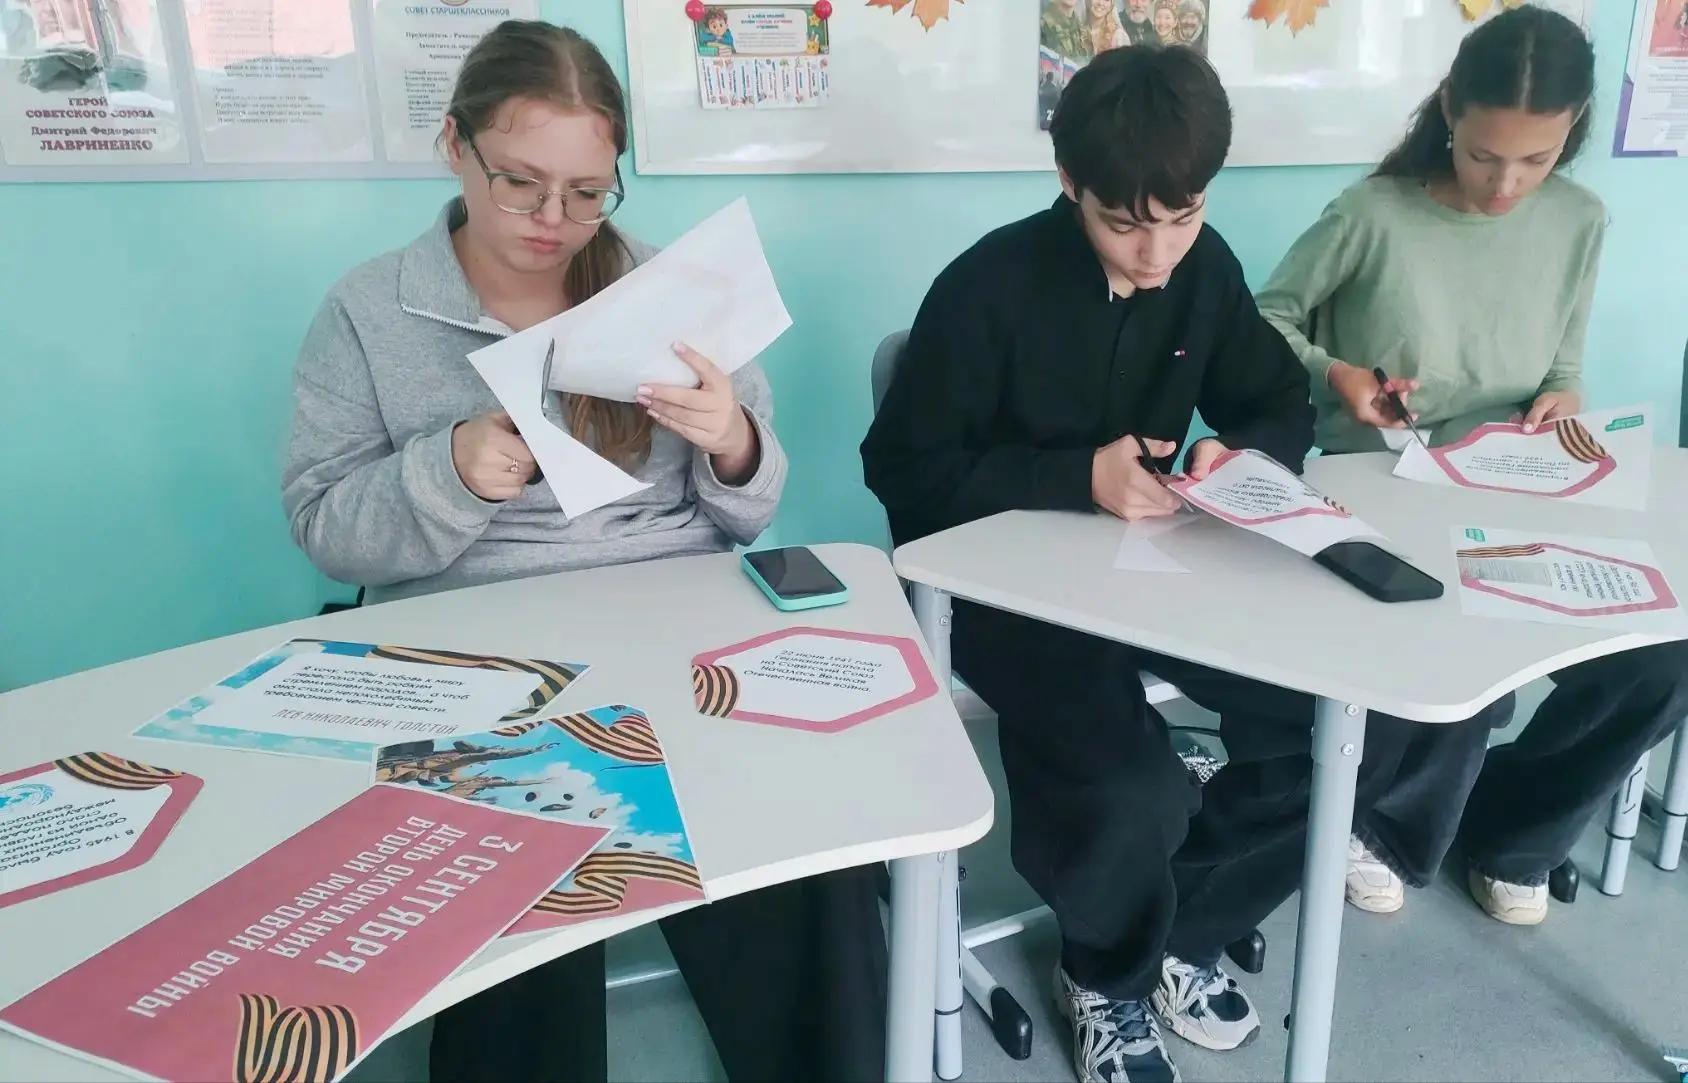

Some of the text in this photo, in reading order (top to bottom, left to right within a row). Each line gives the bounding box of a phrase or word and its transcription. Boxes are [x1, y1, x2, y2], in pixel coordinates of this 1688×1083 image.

[404, 6, 510, 16] СОВЕТ СТАРШЕКЛАССНИКОВ
[68, 96, 108, 106] ГЕРОЙ
[25, 109, 155, 118] СОВЕТСКОГО СОЮЗА
[31, 126, 87, 136] Дмитрий
[40, 140, 153, 151] ЛАВРИНЕНКО
[774, 655, 875, 673] Германия напала
[778, 661, 839, 674] Советский
[795, 652, 825, 660] июня
[828, 655, 852, 663] 1941
[854, 659, 882, 668] года
[292, 672, 355, 682] перестала
[385, 681, 433, 689] робким
[379, 674, 422, 682] любовь
[743, 669, 832, 686] Отечественная
[760, 665, 867, 684] Началась Великая
[282, 678, 363, 689] стремлением
[263, 690, 343, 702] требованием
[345, 698, 394, 708] честной
[297, 686, 333, 694] стала
[334, 690, 434, 704] непоколебимым
[272, 709, 459, 735] ЛЕВ НИКОЛАЕВИЧ ТОЛСТОЙ
[56, 810, 101, 825] стало
[69, 812, 119, 828] одной
[3, 817, 128, 855] Объединенных
[47, 827, 65, 835] из
[85, 834, 120, 848] 1945
[46, 843, 81, 858] году
[266, 822, 468, 960] ДЕНЬ ОКОНЧАНИЯ
[315, 836, 525, 975] 3 СЕНТЯБРЯ
[126, 815, 426, 1019] ВТОРОЙ МИРОВОЙ ВОЙНЫ
